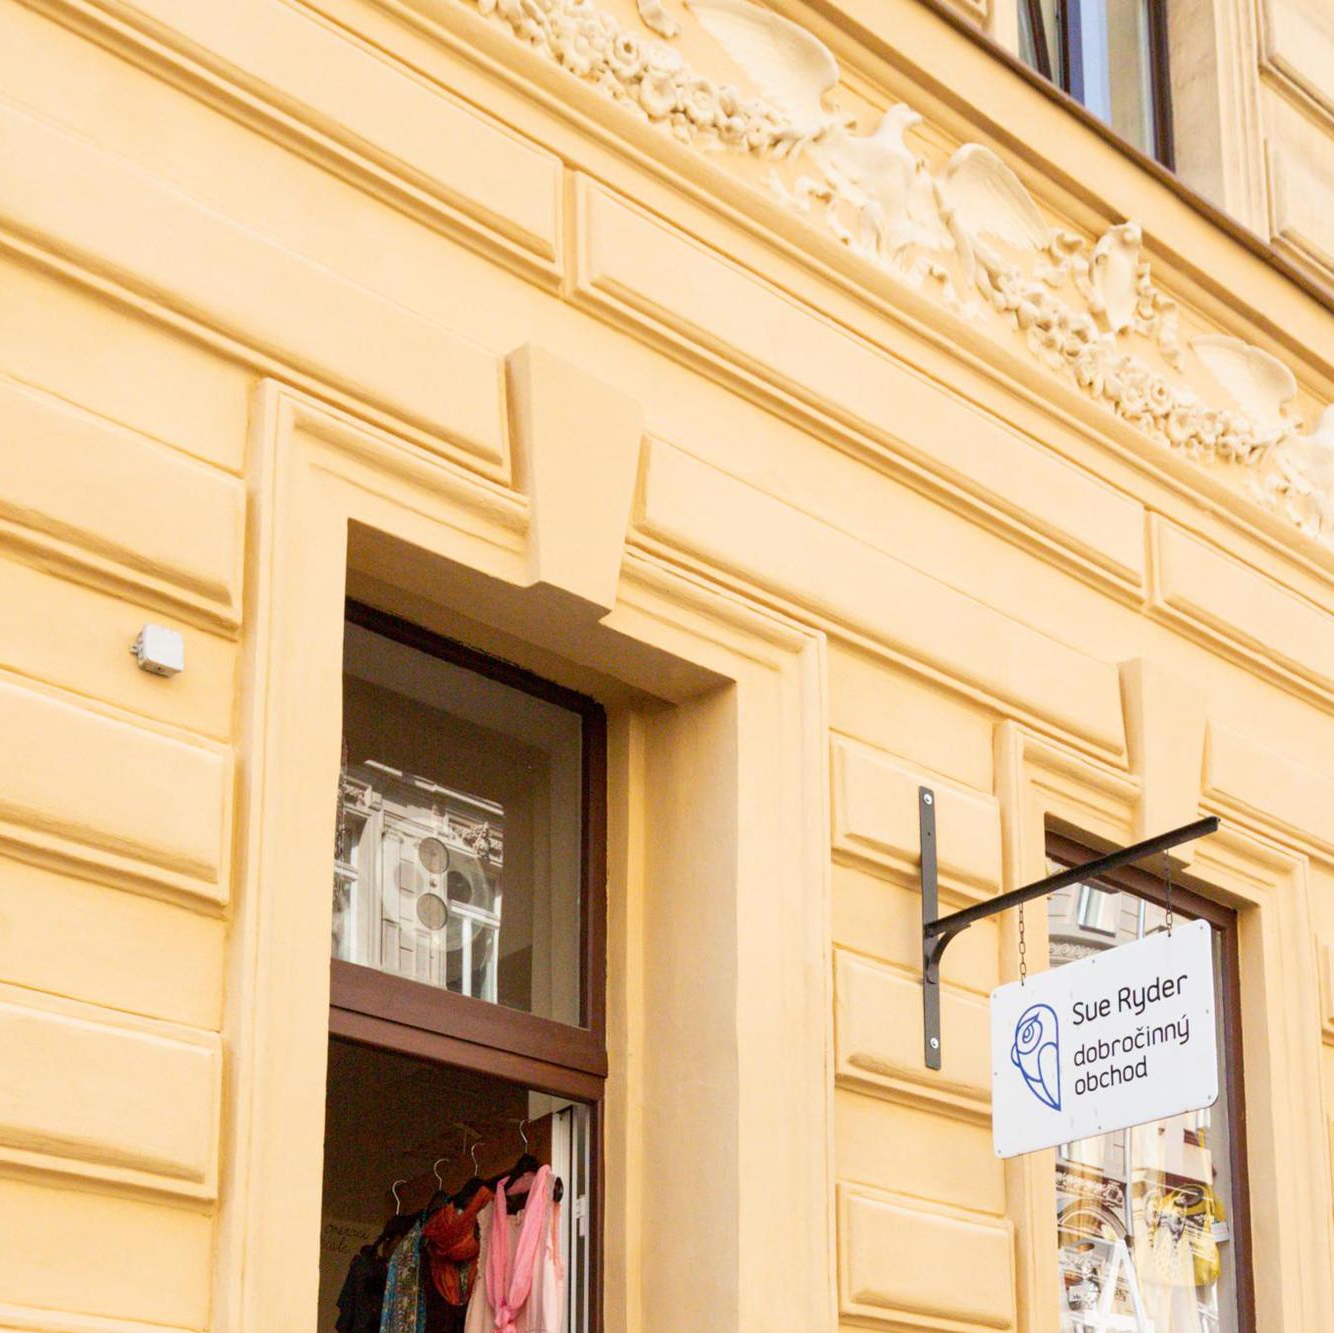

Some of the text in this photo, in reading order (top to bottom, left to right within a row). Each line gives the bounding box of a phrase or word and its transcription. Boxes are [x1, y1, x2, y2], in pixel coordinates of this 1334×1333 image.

[1072, 974, 1188, 1026] Sue Ryder
[1073, 1014, 1190, 1067] dobročinný
[1074, 1055, 1148, 1096] obchod
